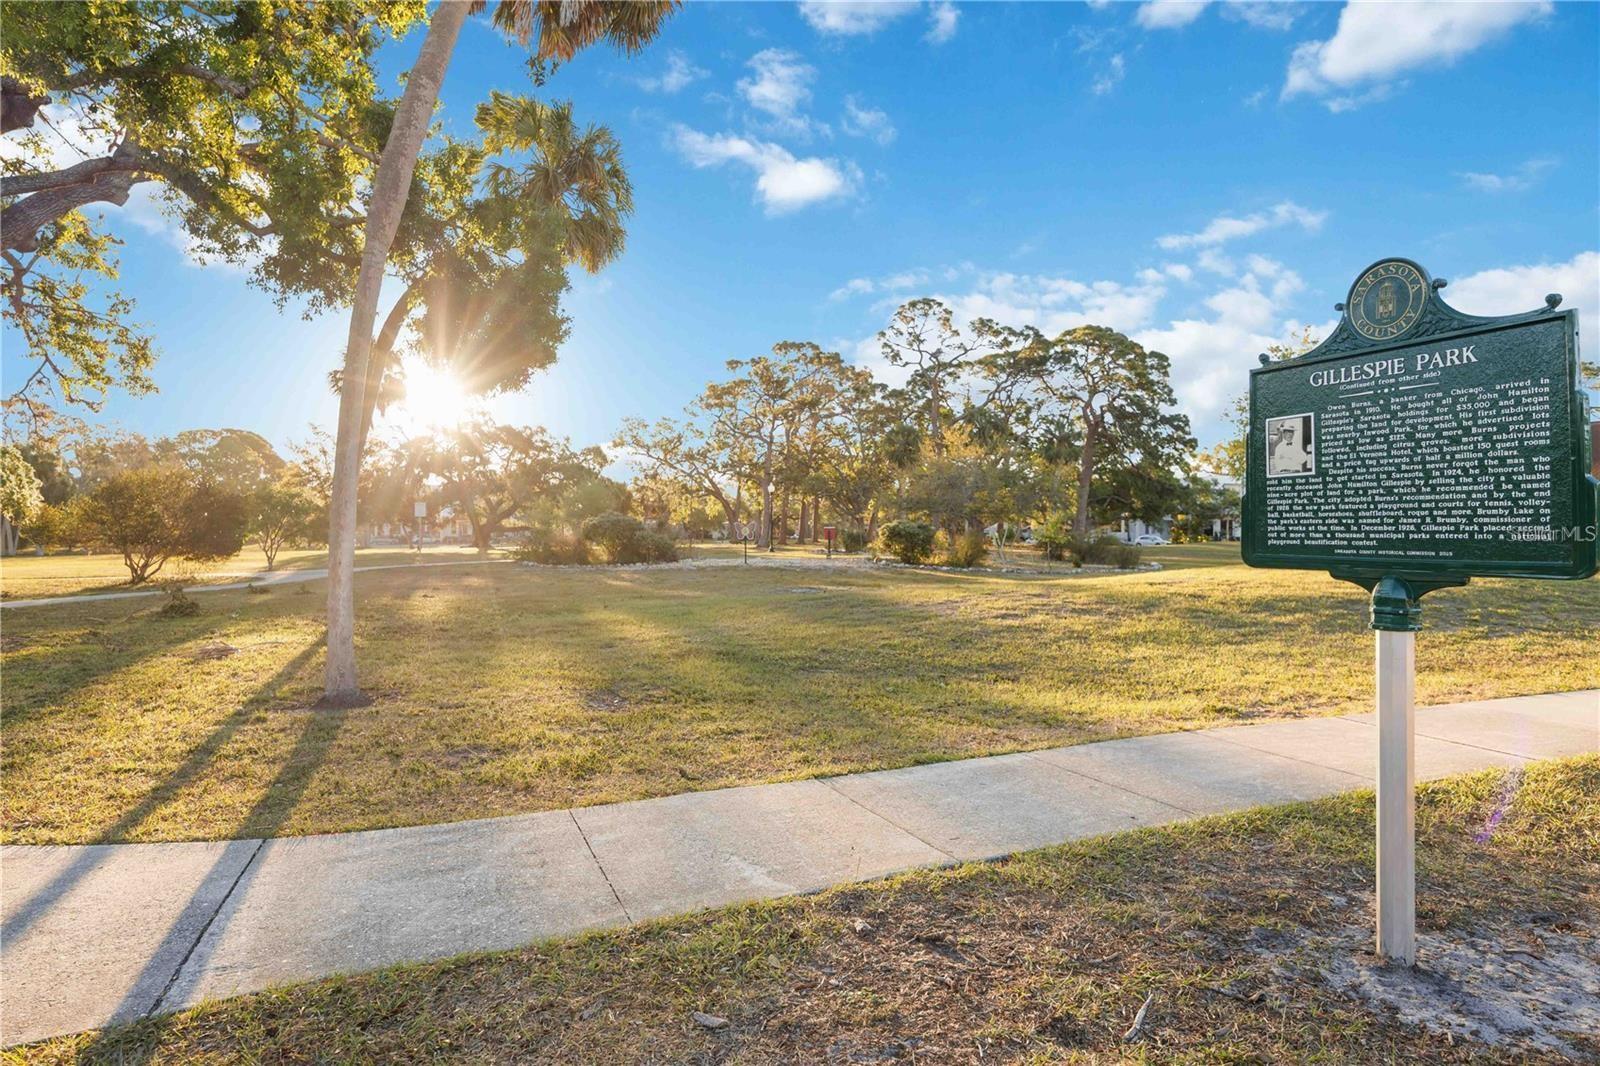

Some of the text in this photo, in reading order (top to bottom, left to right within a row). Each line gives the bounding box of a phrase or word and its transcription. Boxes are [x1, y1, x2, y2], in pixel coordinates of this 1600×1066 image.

[1353, 264, 1420, 304] SARASOTA
[1356, 308, 1415, 336] COUNTY
[1310, 345, 1478, 386] GILLESPIE PARK
[1496, 380, 1530, 389] arrived
[1508, 387, 1549, 396] Hamilton
[1322, 425, 1354, 433] preparing
[1501, 404, 1549, 414] subdivision
[1478, 415, 1523, 424] advertised
[1509, 421, 1550, 431] projects
[1493, 431, 1549, 440] subdivisions
[1496, 441, 1519, 449] guest
